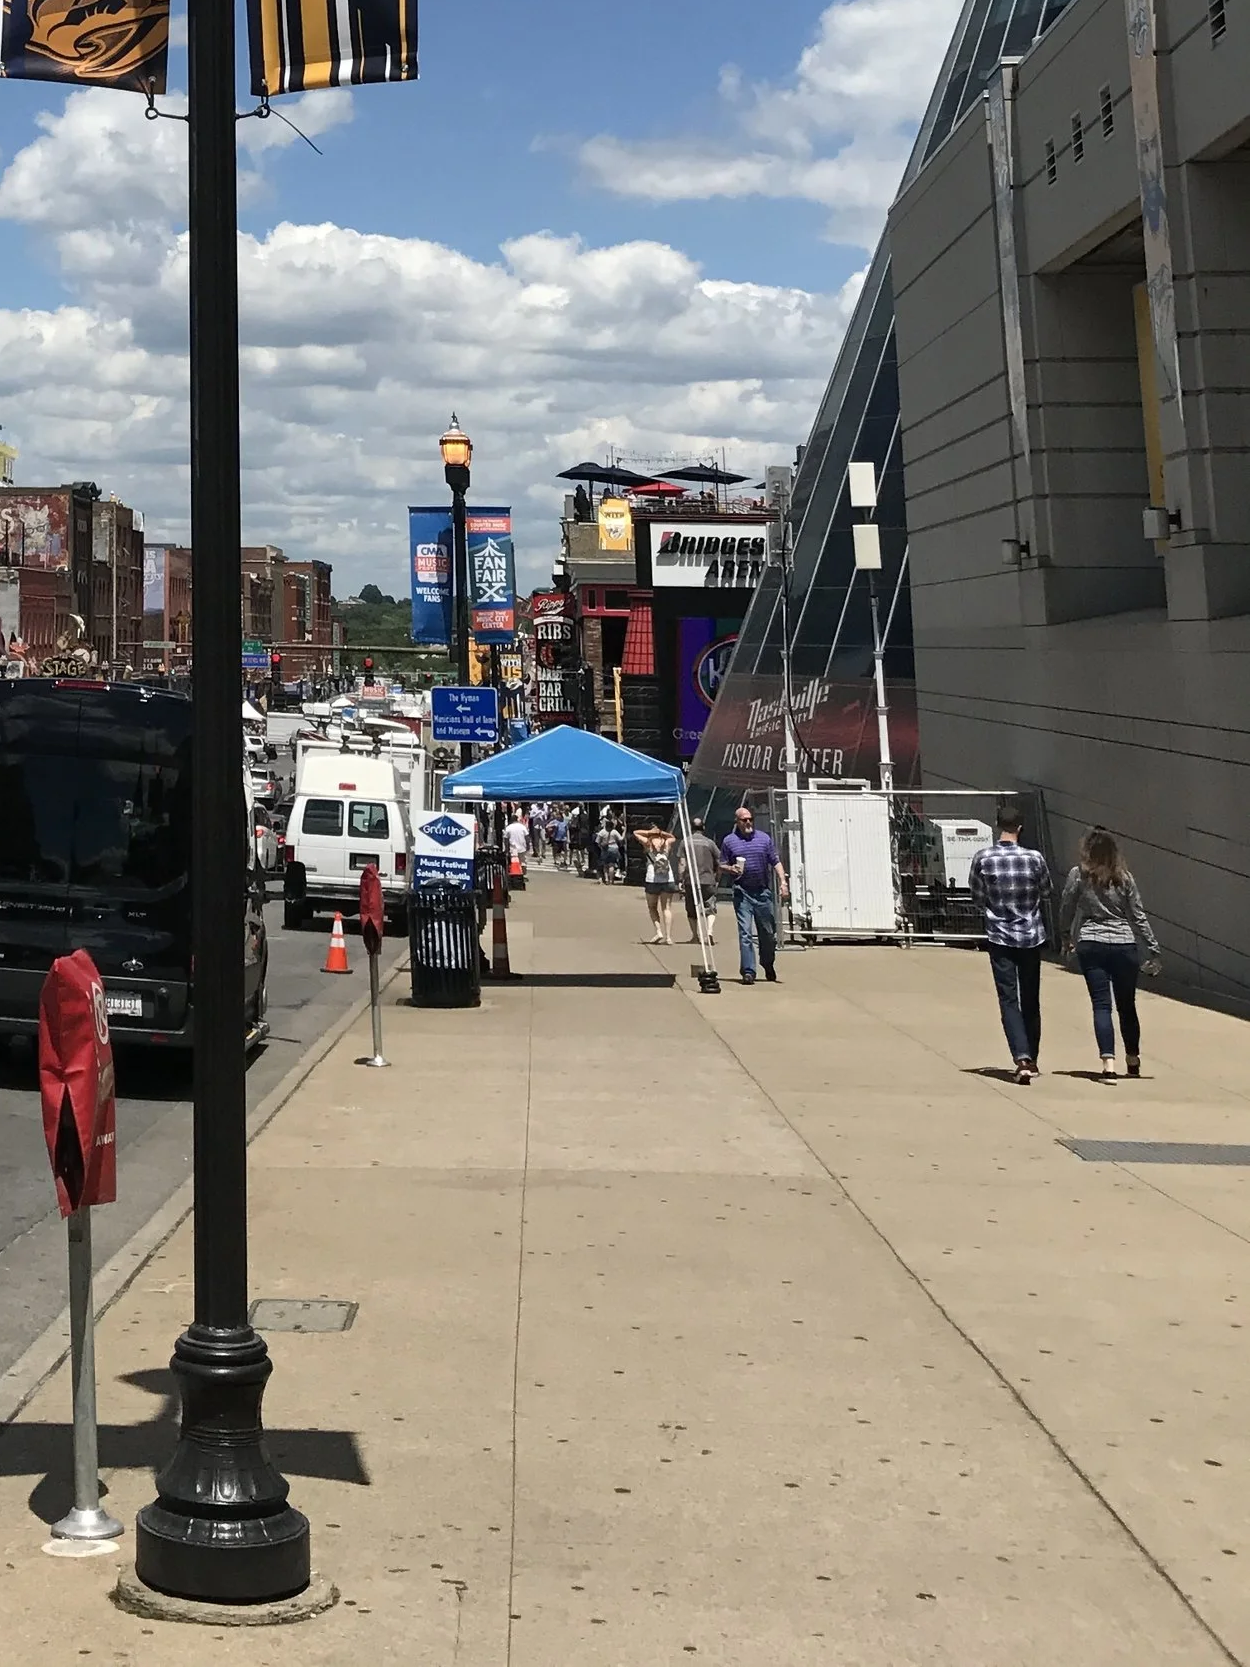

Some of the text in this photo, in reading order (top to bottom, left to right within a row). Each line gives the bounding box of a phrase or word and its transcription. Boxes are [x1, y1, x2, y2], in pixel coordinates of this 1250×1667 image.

[657, 532, 765, 555] BRIDGES
[421, 547, 444, 556] CMA
[418, 559, 447, 568] MUSIC
[474, 557, 507, 570] FAN
[704, 559, 762, 578] AREN
[475, 569, 507, 582] FAIR
[416, 587, 450, 596] WELCOME
[476, 583, 508, 603] X
[482, 622, 504, 630] CENTER
[537, 623, 571, 640] RIBS
[42, 657, 85, 676] STAGE
[501, 666, 522, 678] US
[539, 682, 563, 697] BAR
[449, 693, 459, 702] The
[539, 697, 575, 712] GRILL
[462, 715, 474, 723] Hall
[448, 727, 470, 735] Museum
[672, 728, 703, 740] Grea
[778, 748, 844, 775] CNTER
[423, 825, 446, 835] Gray
[419, 858, 468, 869] Music Festival
[416, 869, 471, 880] Satellite Shuttle
